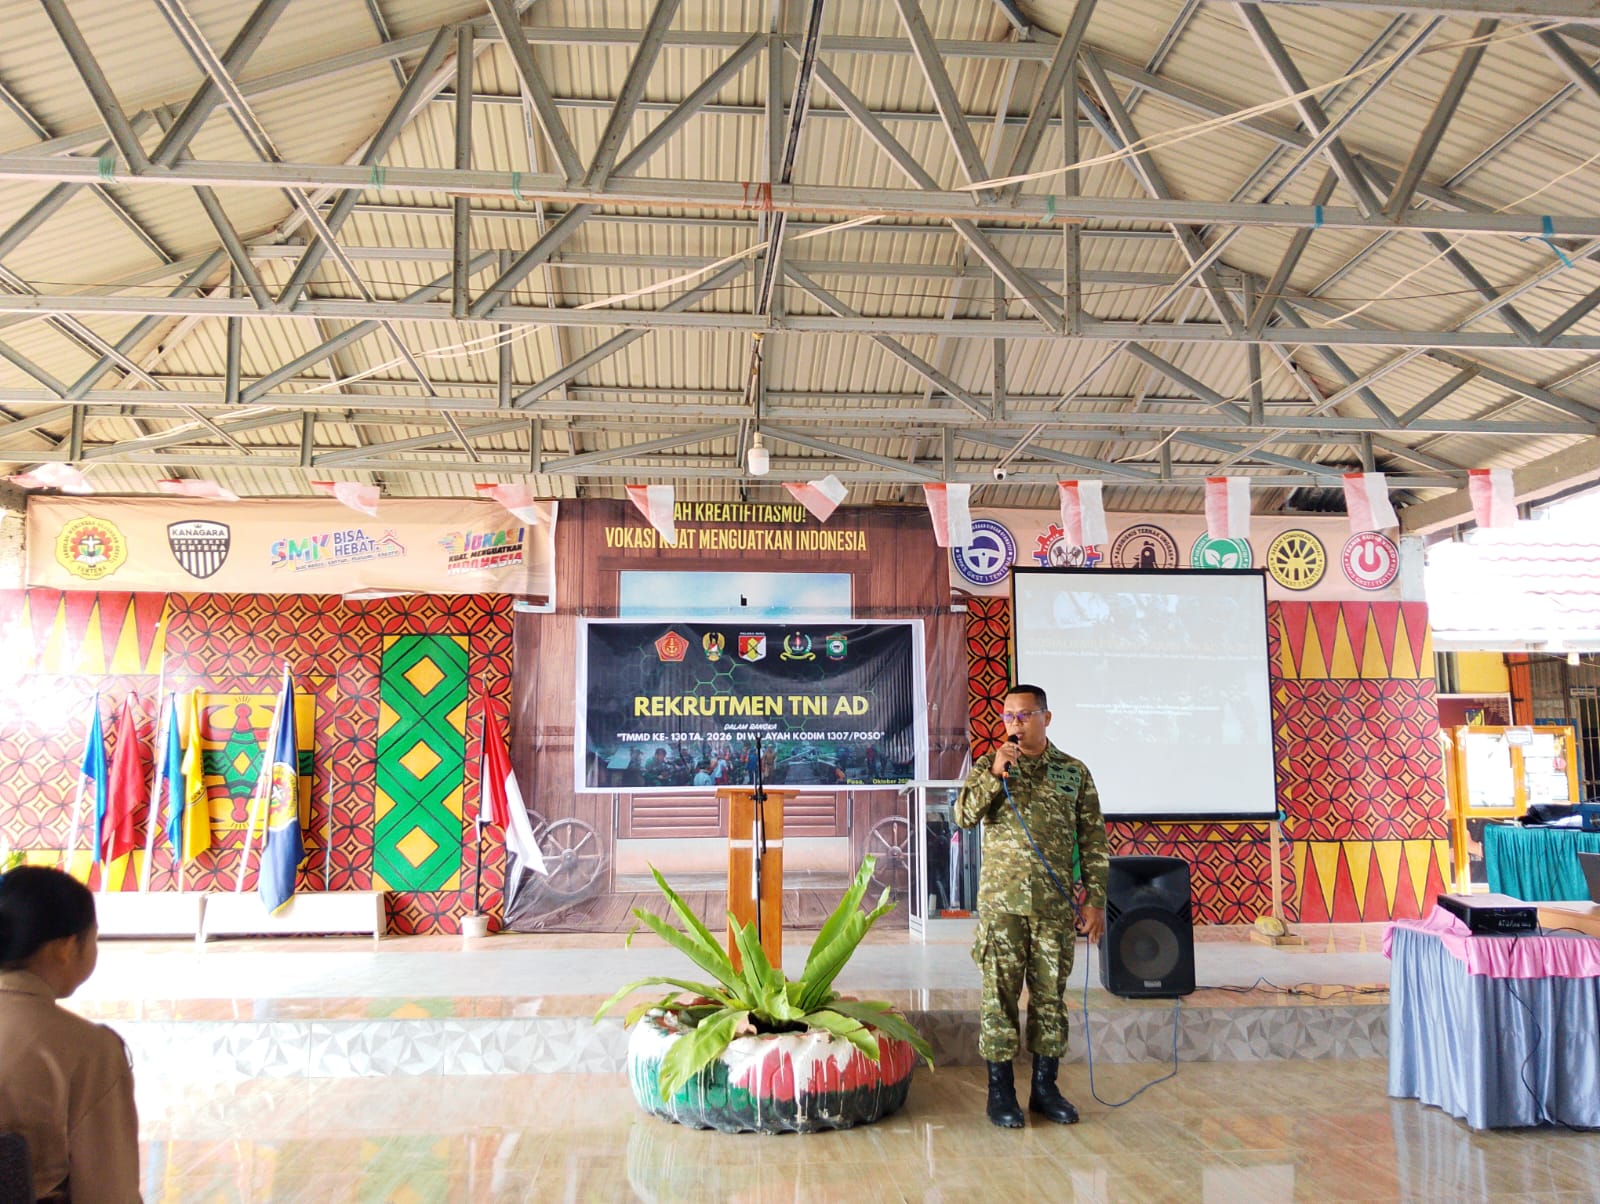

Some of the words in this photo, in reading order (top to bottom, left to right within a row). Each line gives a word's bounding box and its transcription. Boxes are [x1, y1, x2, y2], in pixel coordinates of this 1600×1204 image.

[695, 502, 806, 523] KREATIFITASMU!
[172, 528, 226, 536] KANAGARA
[334, 529, 369, 544] BISA.
[605, 527, 656, 549] VOKASI
[699, 528, 793, 551] MENGUATKAN
[796, 530, 866, 551] INDONESIA
[271, 534, 330, 569] SMK
[334, 540, 380, 556] HEBAT.
[634, 695, 783, 717] REKRUTMEN
[788, 695, 828, 716] TNI
[833, 695, 869, 716] AD
[723, 723, 749, 731] DALAM
[617, 733, 650, 742] "TMMD
[652, 733, 669, 741] KE-
[671, 733, 688, 741] 130
[689, 733, 704, 741] TA.
[706, 732, 732, 741] 2026
[736, 732, 746, 741] DI
[792, 732, 825, 740] KODIM
[827, 731, 885, 742] 1307/POSO"
[872, 777, 897, 785] Oktober
